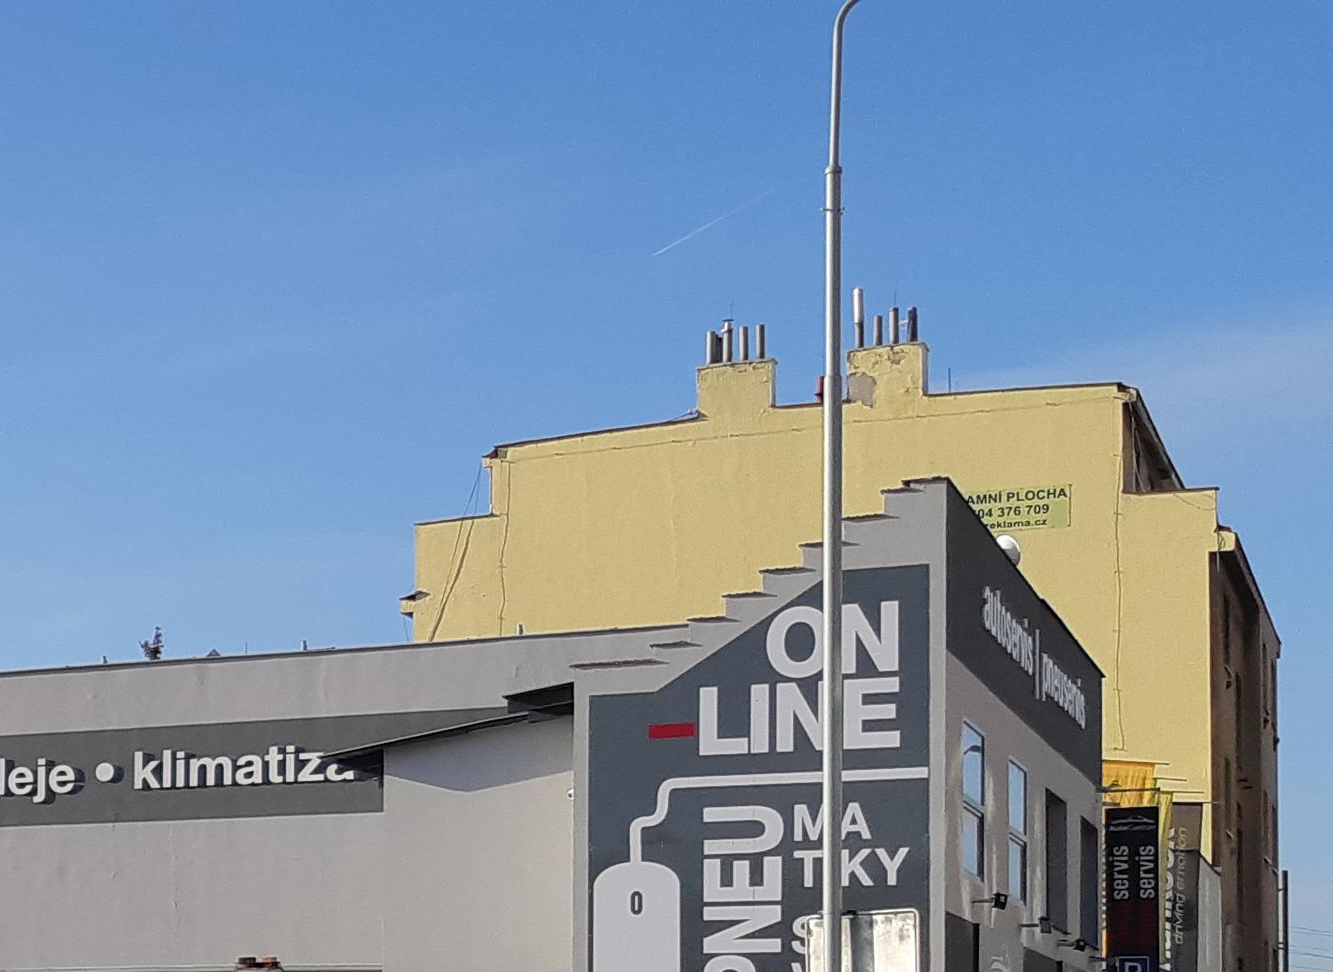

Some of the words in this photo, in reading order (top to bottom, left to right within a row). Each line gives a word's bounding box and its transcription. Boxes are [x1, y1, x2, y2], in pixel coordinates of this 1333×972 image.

[998, 506, 1021, 517] 376
[1025, 504, 1049, 515] 709
[1007, 488, 1068, 502] PLOCHA
[766, 600, 900, 679] ON
[983, 586, 1033, 676] autoservis
[1042, 652, 1085, 729] pneuservis
[793, 802, 872, 842] MA
[793, 846, 910, 888] TKY
[1109, 845, 1130, 900] servis
[1135, 845, 1156, 900] servis
[1174, 892, 1186, 945] driving
